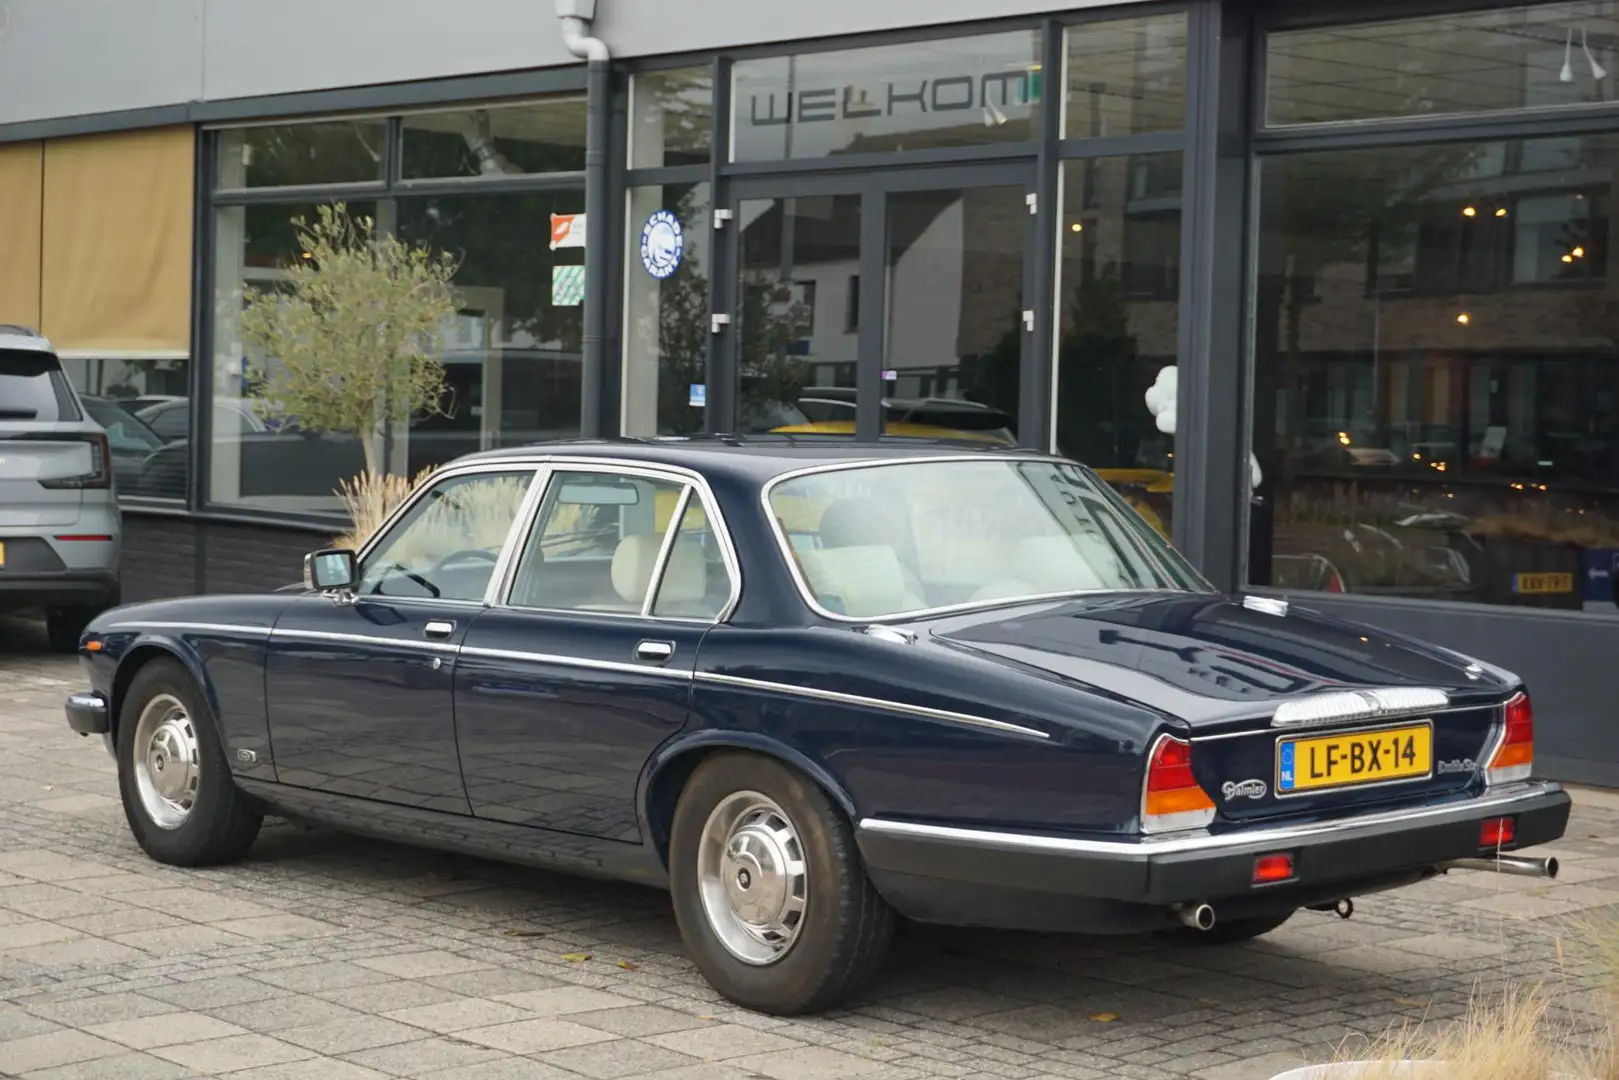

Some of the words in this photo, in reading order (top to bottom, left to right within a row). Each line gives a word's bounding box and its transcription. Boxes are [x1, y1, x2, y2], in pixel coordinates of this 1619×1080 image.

[750, 70, 1029, 126] WELKOM
[1308, 734, 1417, 779] LF-BX-14
[1221, 779, 1267, 801] Daimler
[1280, 769, 1294, 783] NL
